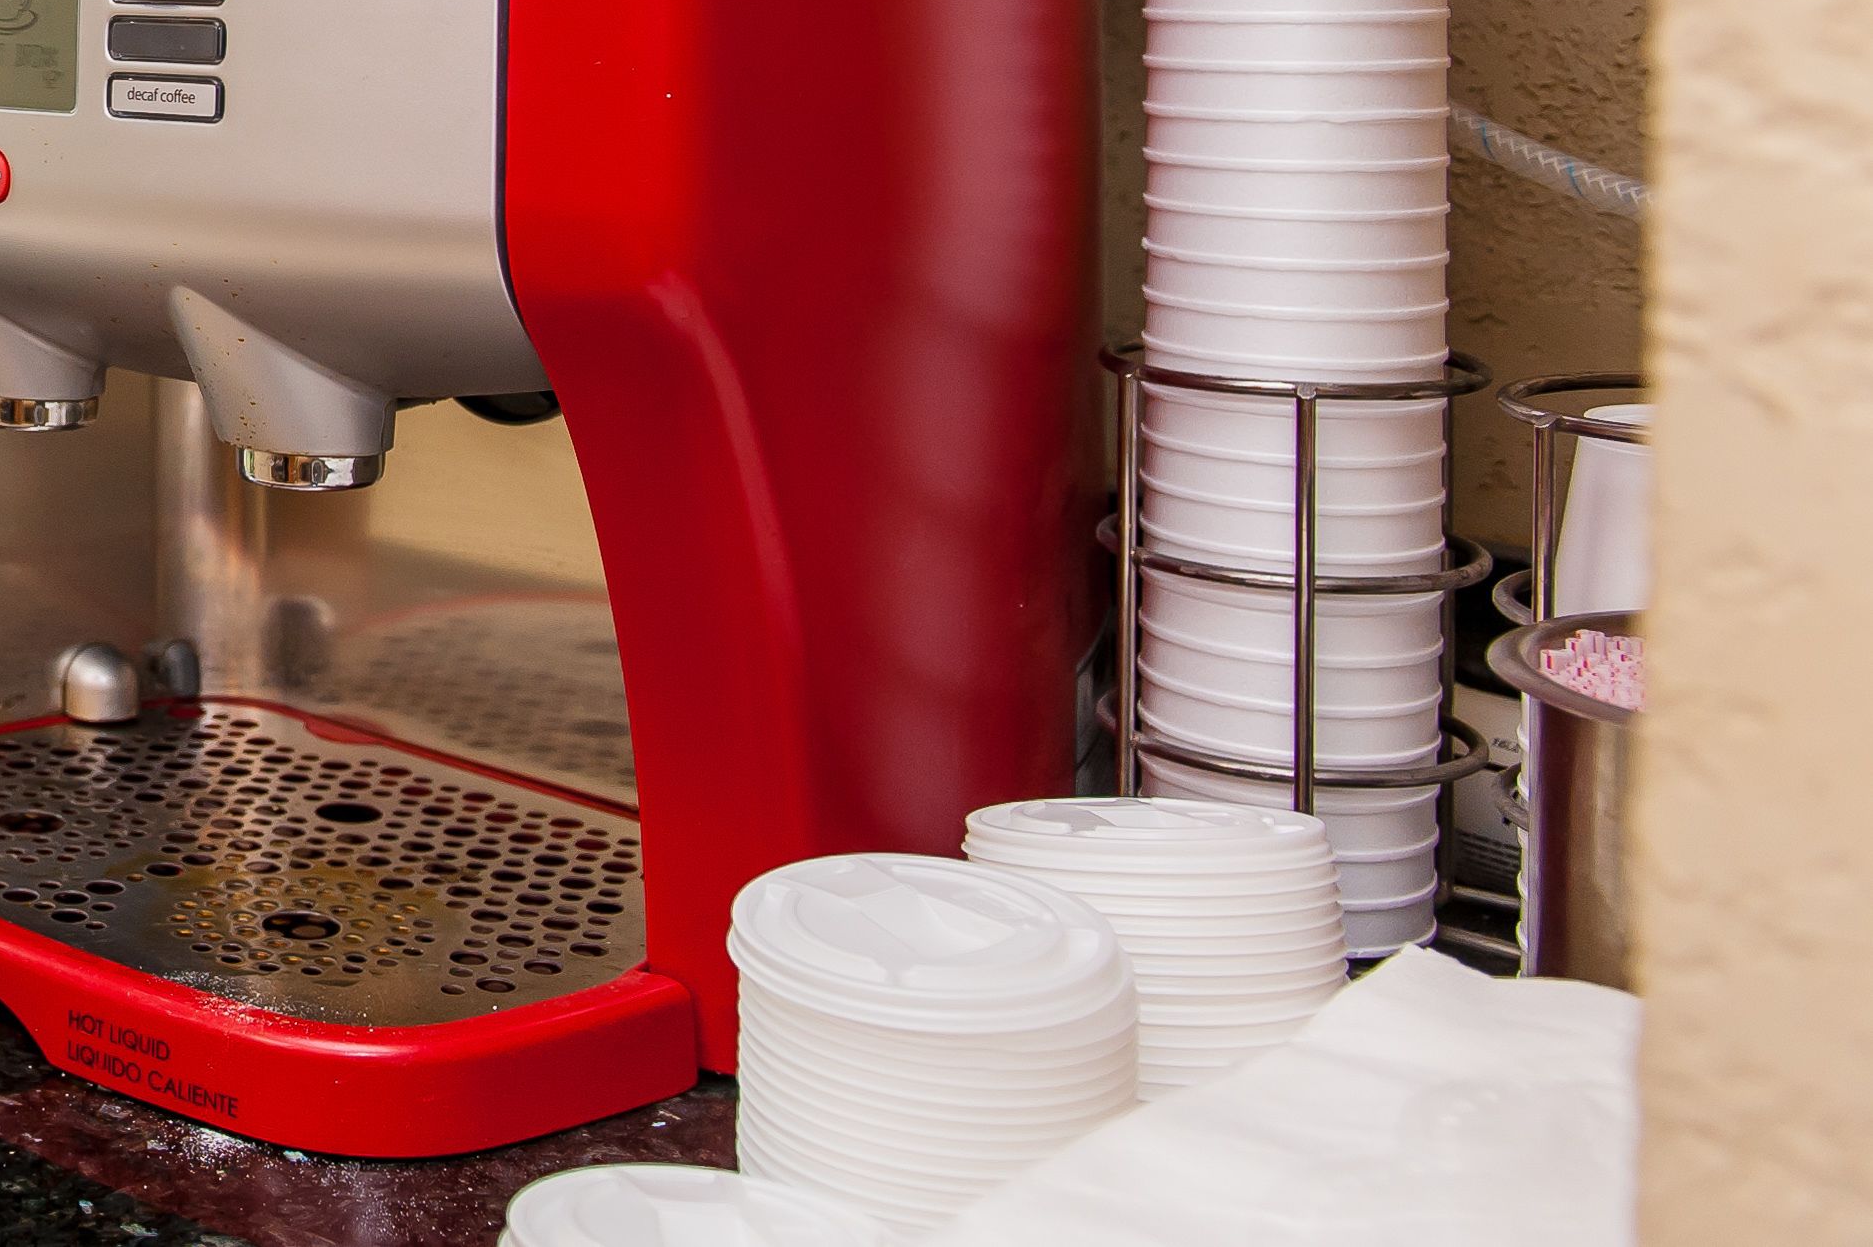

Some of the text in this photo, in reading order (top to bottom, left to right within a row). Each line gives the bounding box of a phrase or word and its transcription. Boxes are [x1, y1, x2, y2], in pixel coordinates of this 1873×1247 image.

[127, 86, 196, 105] decaf coffee
[68, 1009, 171, 1061] HOT LIQUID
[68, 1040, 239, 1120] LIQUIDO CALIENTE
